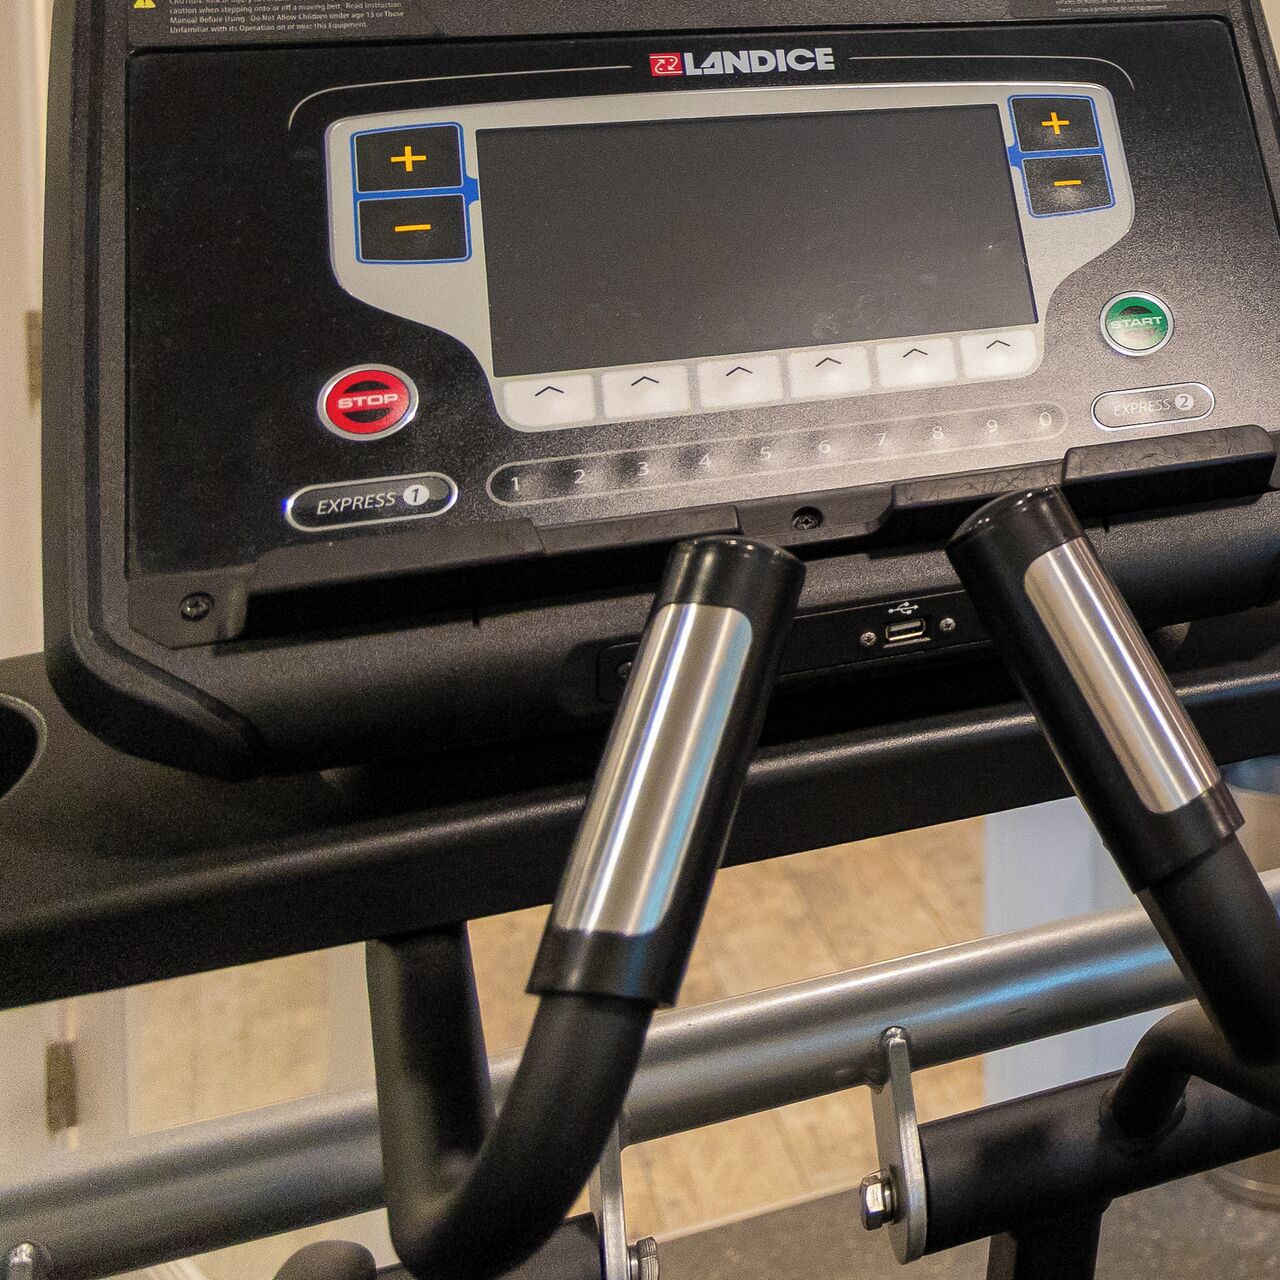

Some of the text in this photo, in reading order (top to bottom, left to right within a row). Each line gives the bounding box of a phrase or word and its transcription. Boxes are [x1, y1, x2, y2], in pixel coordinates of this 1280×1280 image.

[684, 48, 835, 76] LANDICE
[1110, 316, 1162, 329] START
[337, 393, 399, 409] STOP
[1113, 396, 1189, 417] EXPRESS 2
[511, 476, 520, 491] 1
[574, 469, 587, 484] 2
[637, 461, 649, 476] 3
[699, 453, 711, 470] 4
[760, 446, 772, 461] 5
[818, 439, 831, 454] 6
[876, 432, 887, 447] 7
[932, 426, 944, 440] 8
[986, 419, 997, 433] 9
[316, 488, 420, 515] EXPRESS 1
